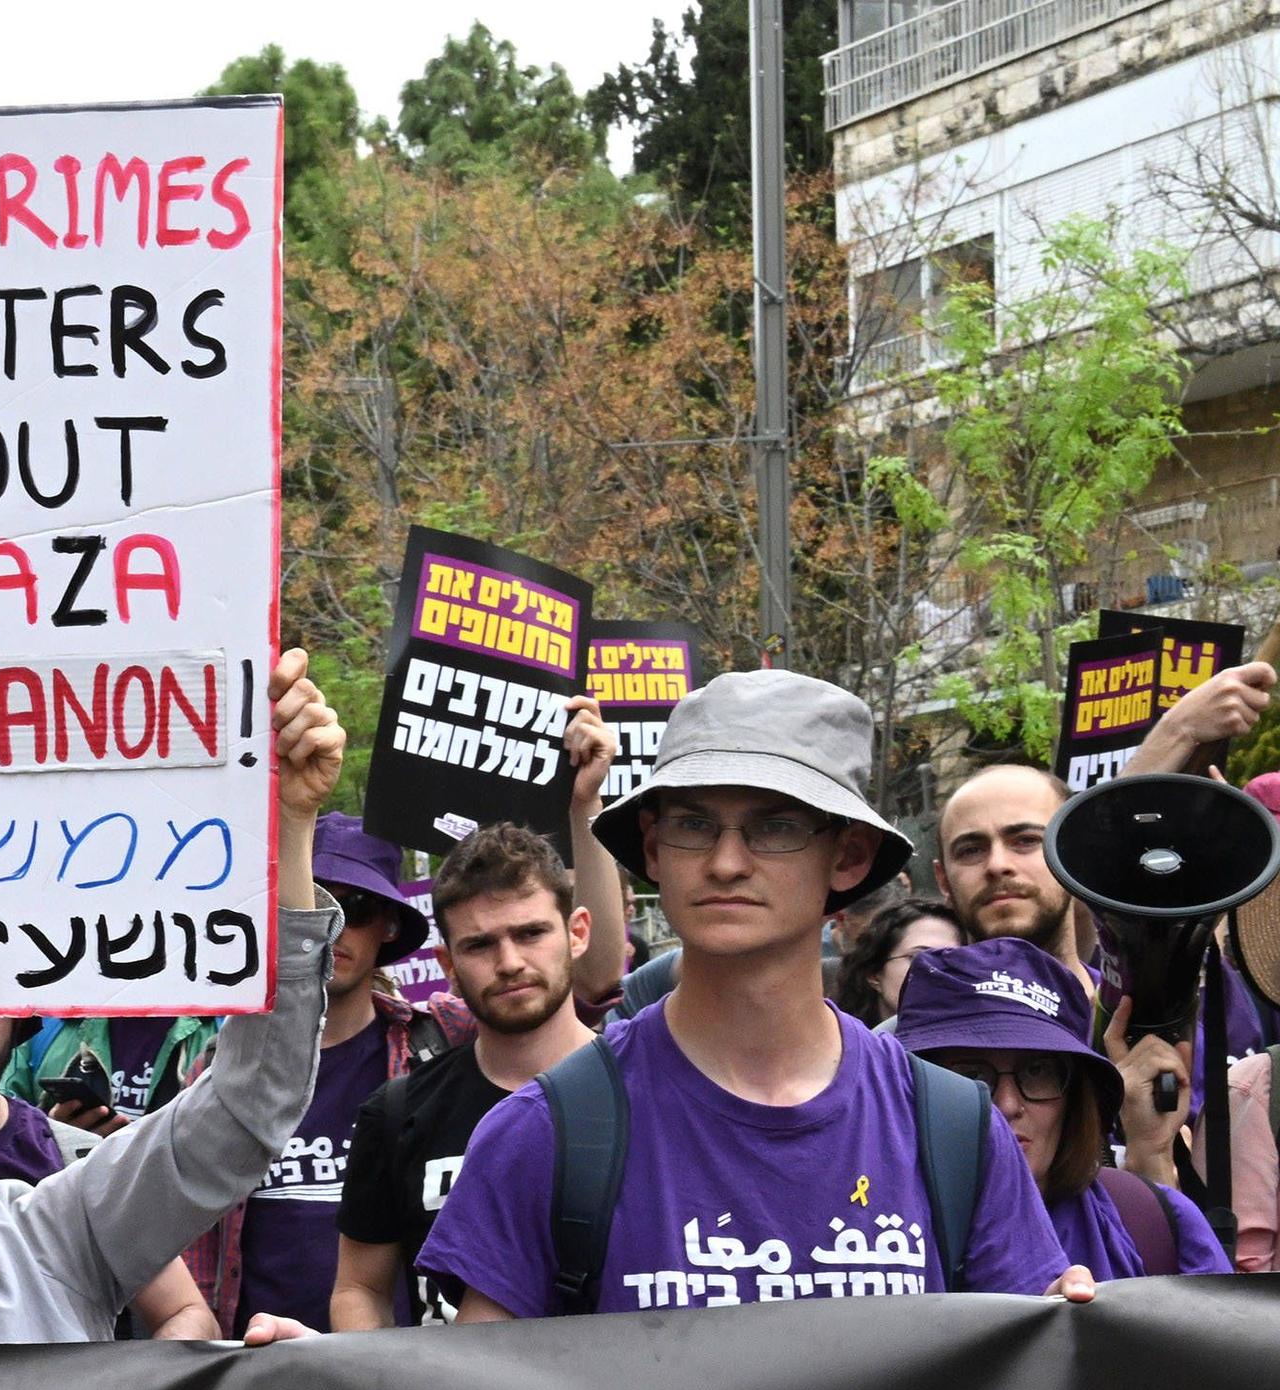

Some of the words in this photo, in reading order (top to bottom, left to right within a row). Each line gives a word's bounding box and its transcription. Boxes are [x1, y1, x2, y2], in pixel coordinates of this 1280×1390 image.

[426, 563, 473, 600] את
[478, 576, 573, 632] מצילים
[419, 599, 572, 671] החטופים
[601, 642, 685, 669] מצילים
[1080, 668, 1108, 696] את
[1109, 659, 1154, 692] מצילים
[402, 658, 573, 738] מסרבים
[1076, 689, 1152, 733] החטופים
[393, 711, 560, 786] למלחמה
[811, 1214, 926, 1267] نقف
[624, 1270, 741, 1309] ביחד
